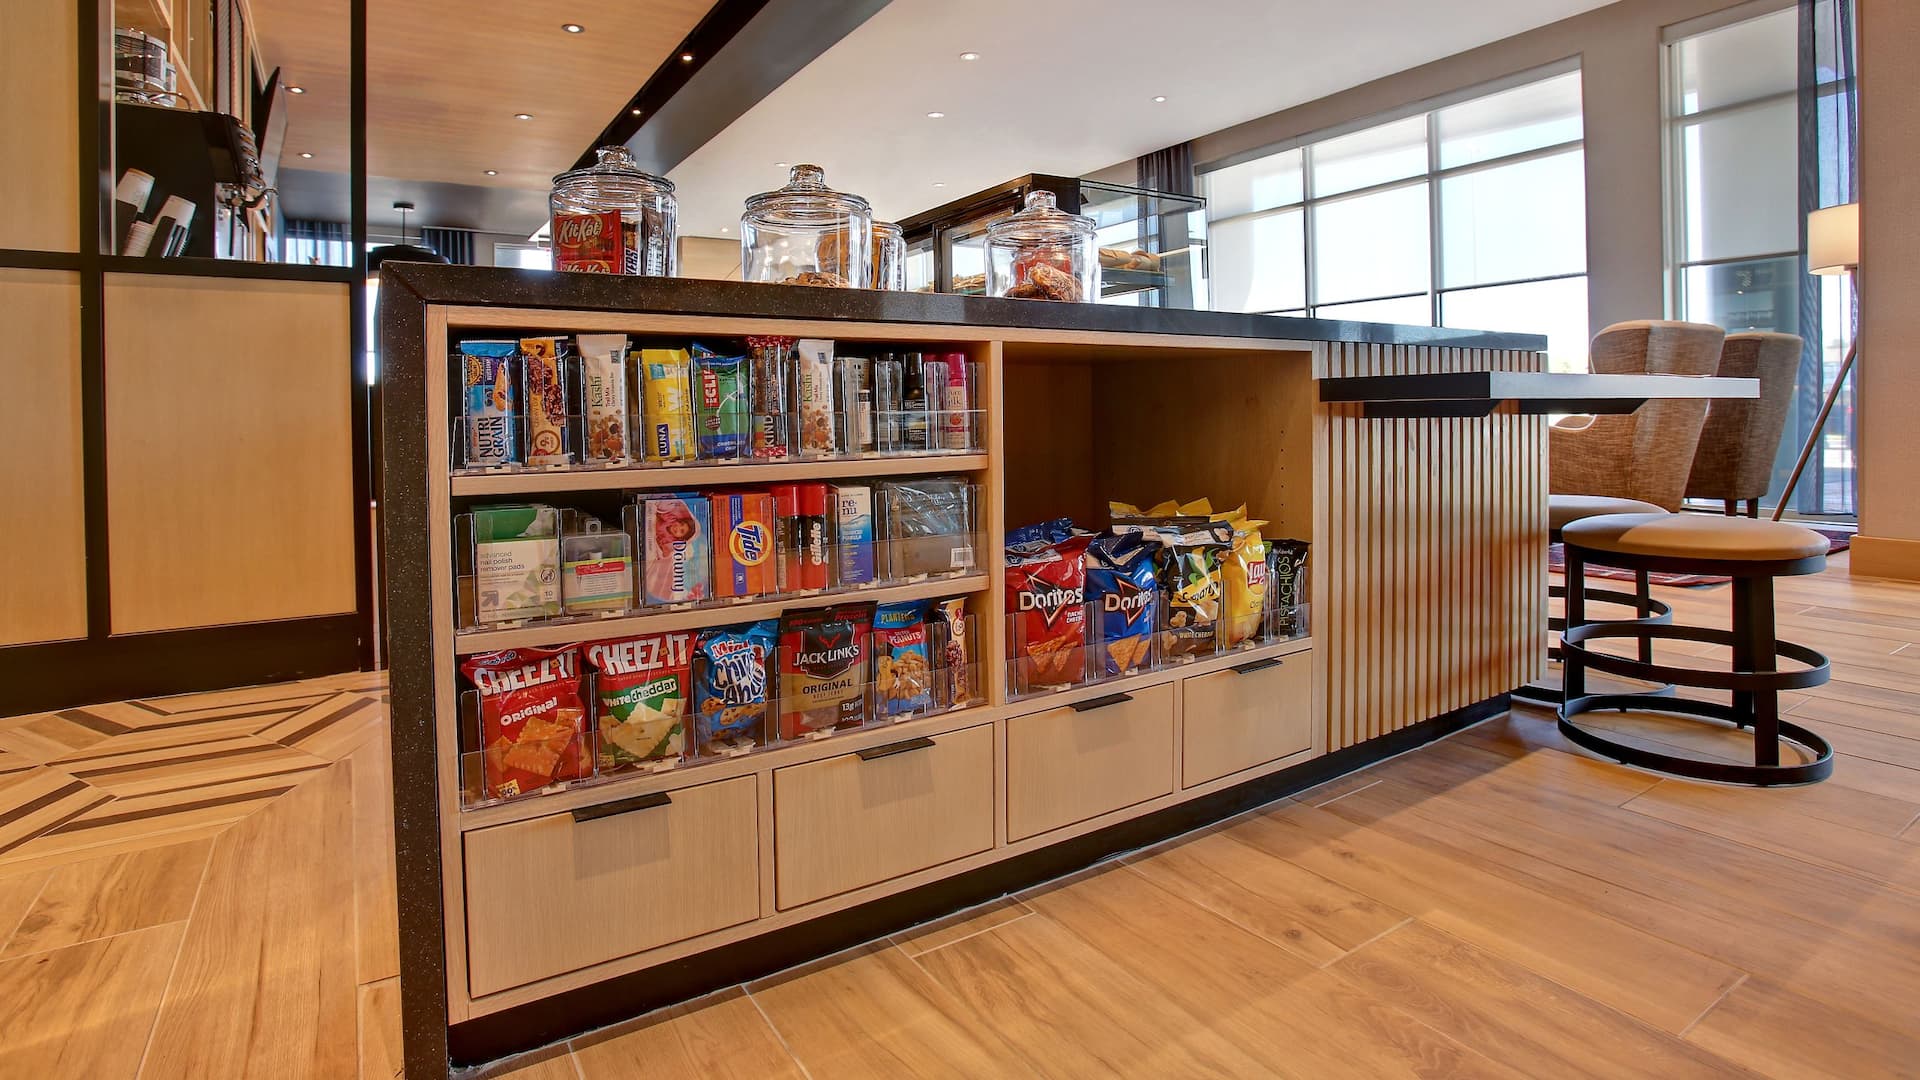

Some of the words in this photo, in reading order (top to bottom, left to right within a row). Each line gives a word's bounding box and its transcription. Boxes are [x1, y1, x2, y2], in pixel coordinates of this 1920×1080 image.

[590, 376, 603, 407] Kashi
[803, 374, 812, 402] Kashi
[477, 417, 493, 458] NUTRI
[490, 416, 505, 458] GRAIN
[658, 427, 668, 454] LUNA
[763, 415, 774, 447] KIND
[736, 525, 761, 561] Tide
[809, 522, 822, 566] Gillette
[671, 541, 687, 592] Downy
[1019, 588, 1083, 611] Doritos
[1277, 556, 1293, 626] PISTACHIOS
[793, 651, 828, 667] JACK
[632, 680, 676, 702] cheddar
[802, 679, 853, 695] ORIGINAL
